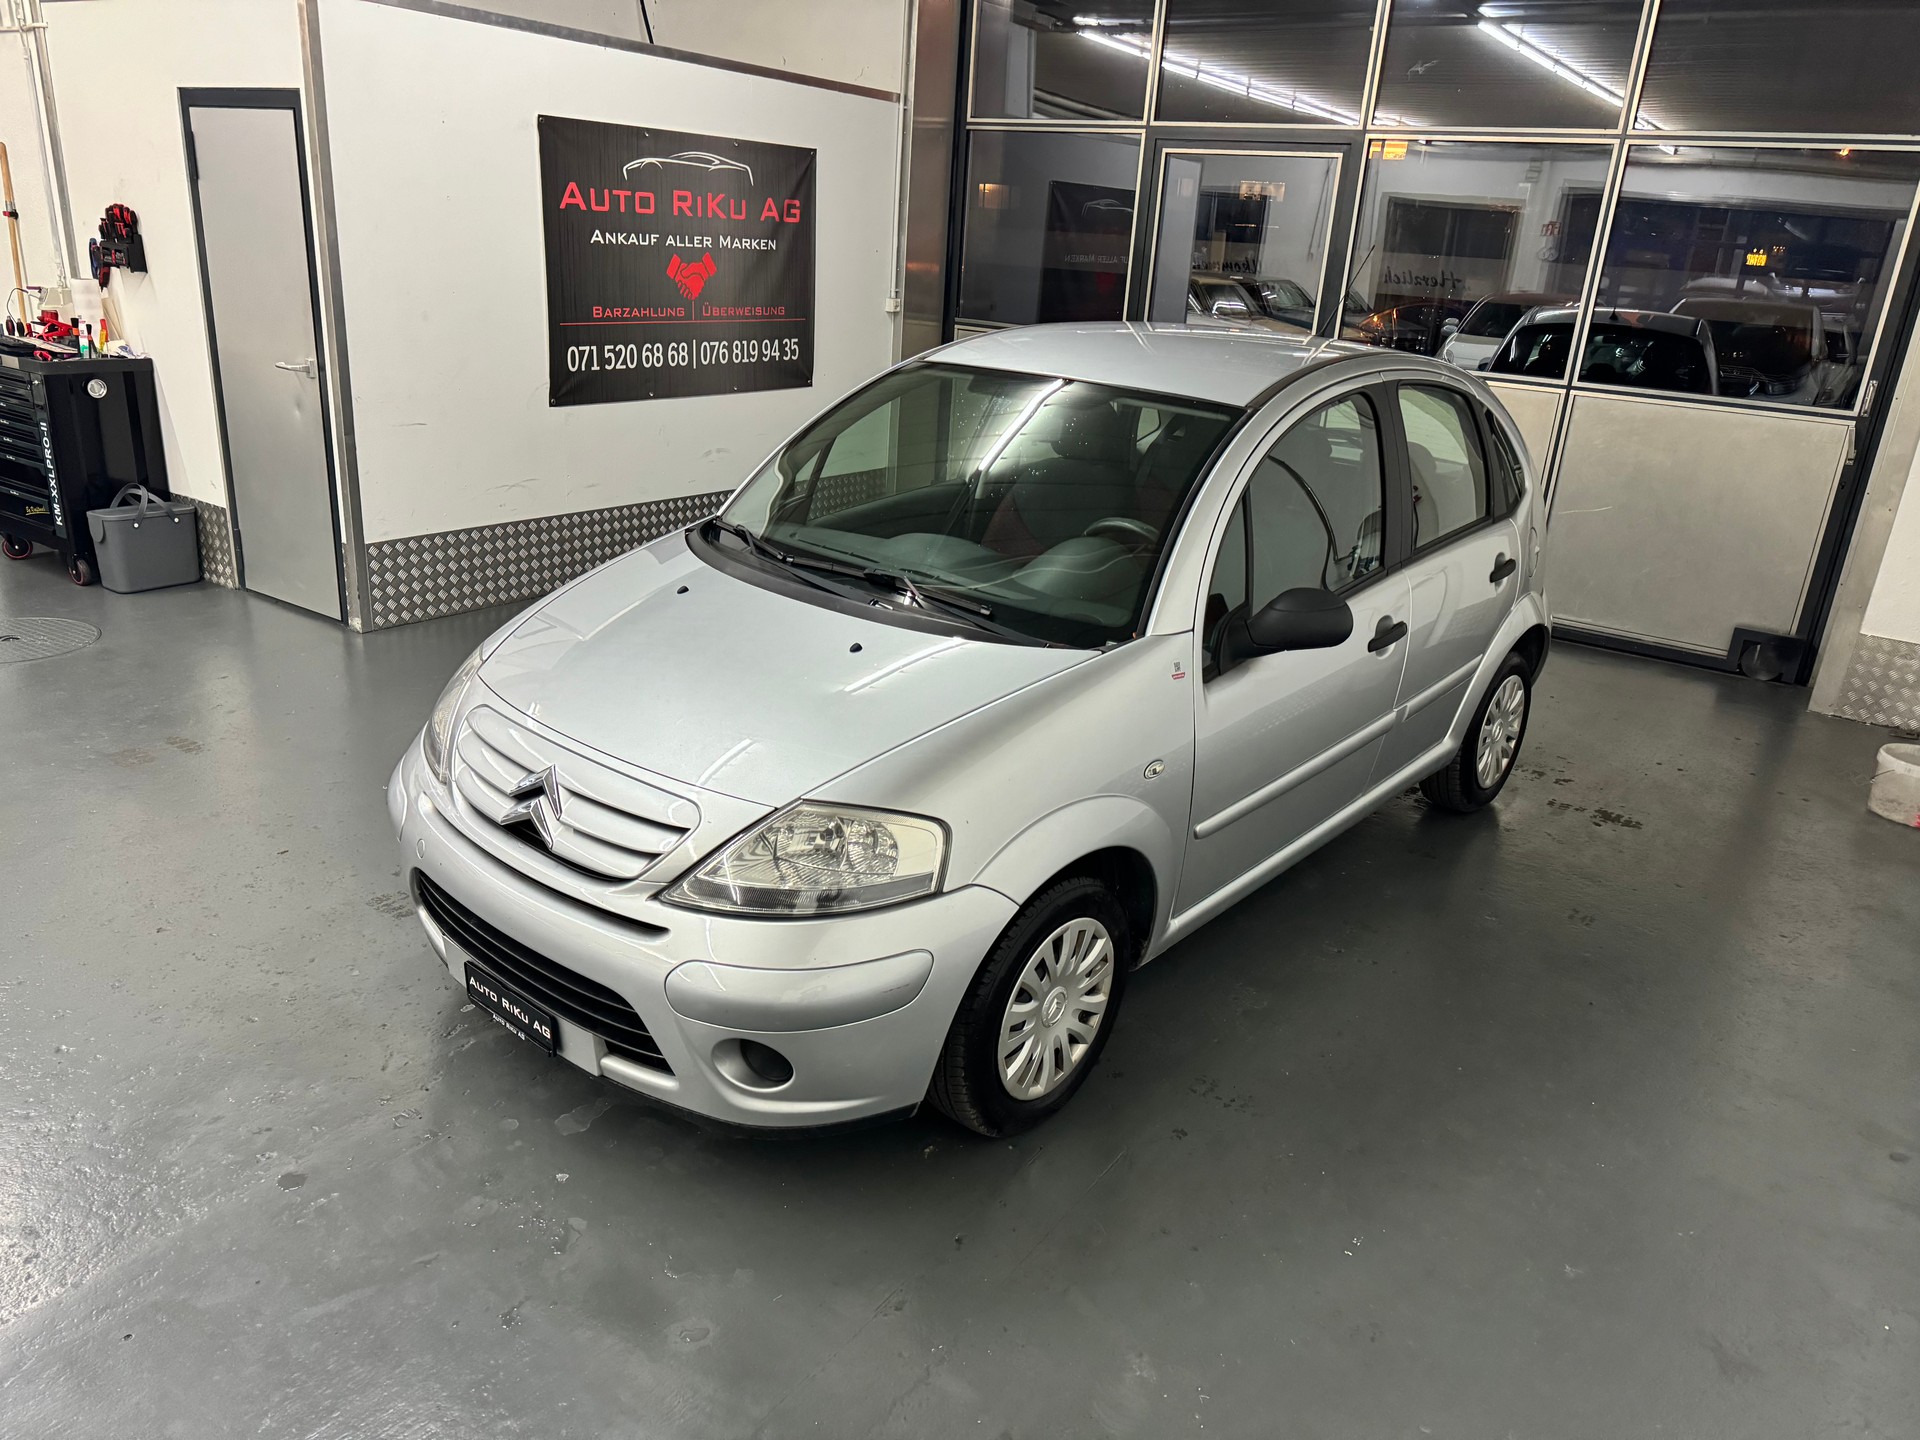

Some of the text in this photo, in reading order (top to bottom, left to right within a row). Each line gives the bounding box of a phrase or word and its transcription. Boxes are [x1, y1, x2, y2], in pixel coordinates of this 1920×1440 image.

[559, 182, 655, 214] AUTO
[760, 197, 801, 223] AG
[590, 229, 777, 250] ANKAUF ALLER MARKEN
[592, 302, 785, 318] BARZAHLUNG ÜBERWEISUNG
[567, 338, 799, 372] 071 520 68 68 076 819 94 35
[40, 421, 63, 526] KM-XXLPRO-II
[469, 976, 498, 1003] AUTO
[533, 1020, 551, 1040] AG
